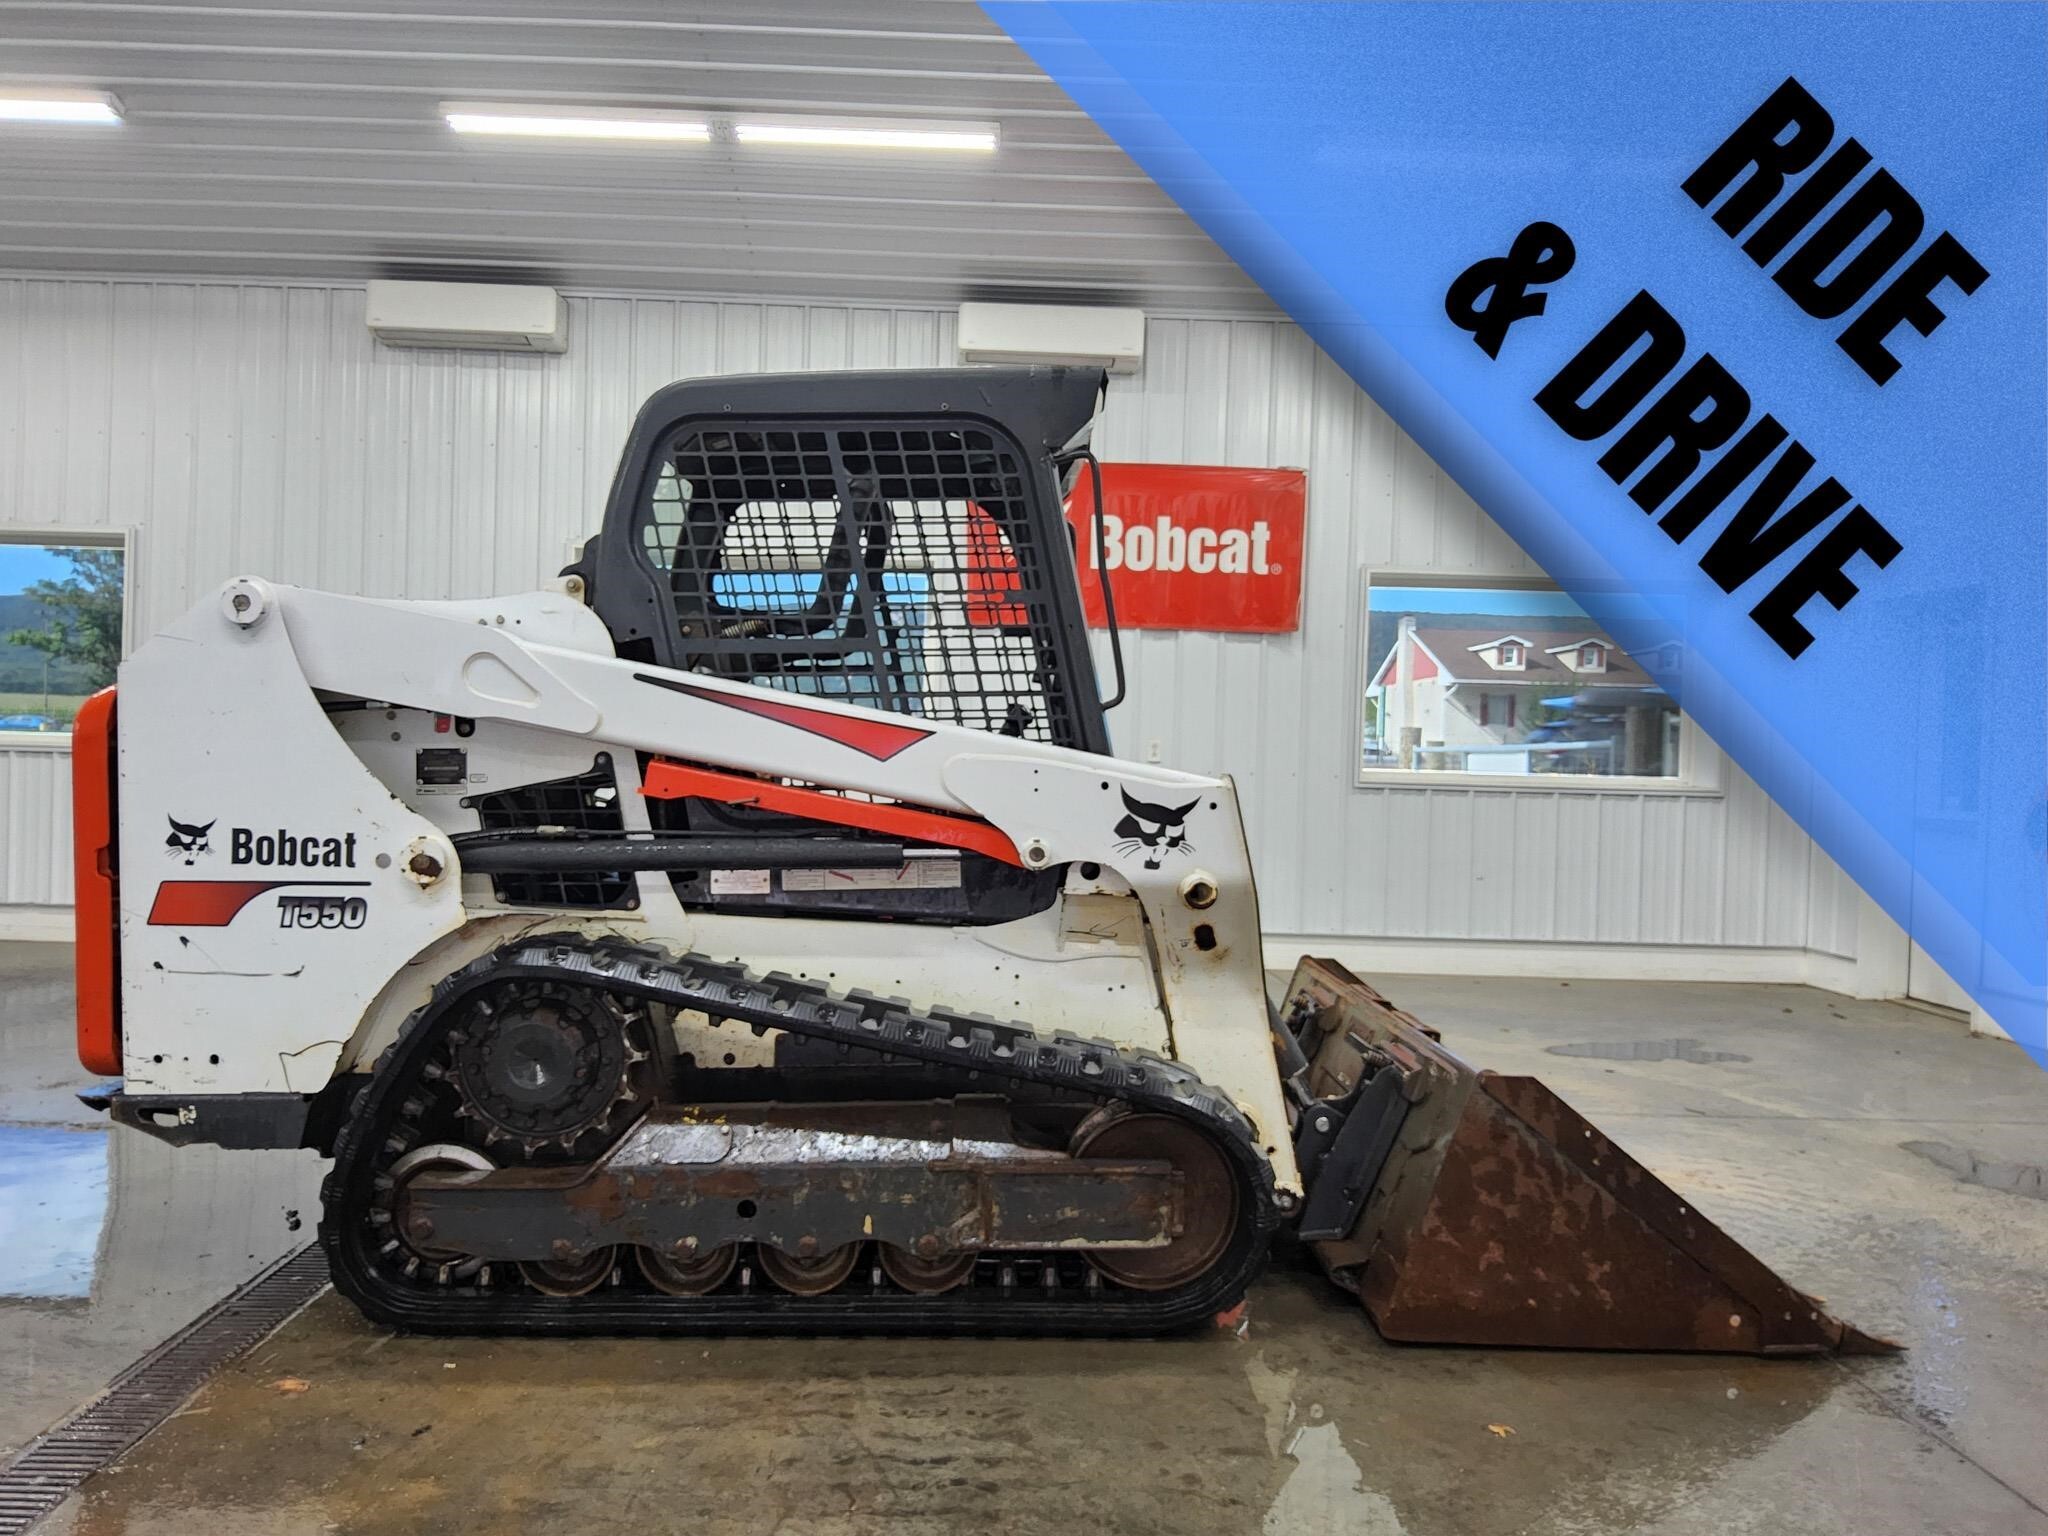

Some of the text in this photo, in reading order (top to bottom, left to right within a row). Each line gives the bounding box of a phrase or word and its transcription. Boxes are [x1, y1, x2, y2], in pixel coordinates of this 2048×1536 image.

[1089, 514, 1270, 575] Bobcat
[231, 827, 356, 868] Bobcat
[277, 895, 368, 930] T550
